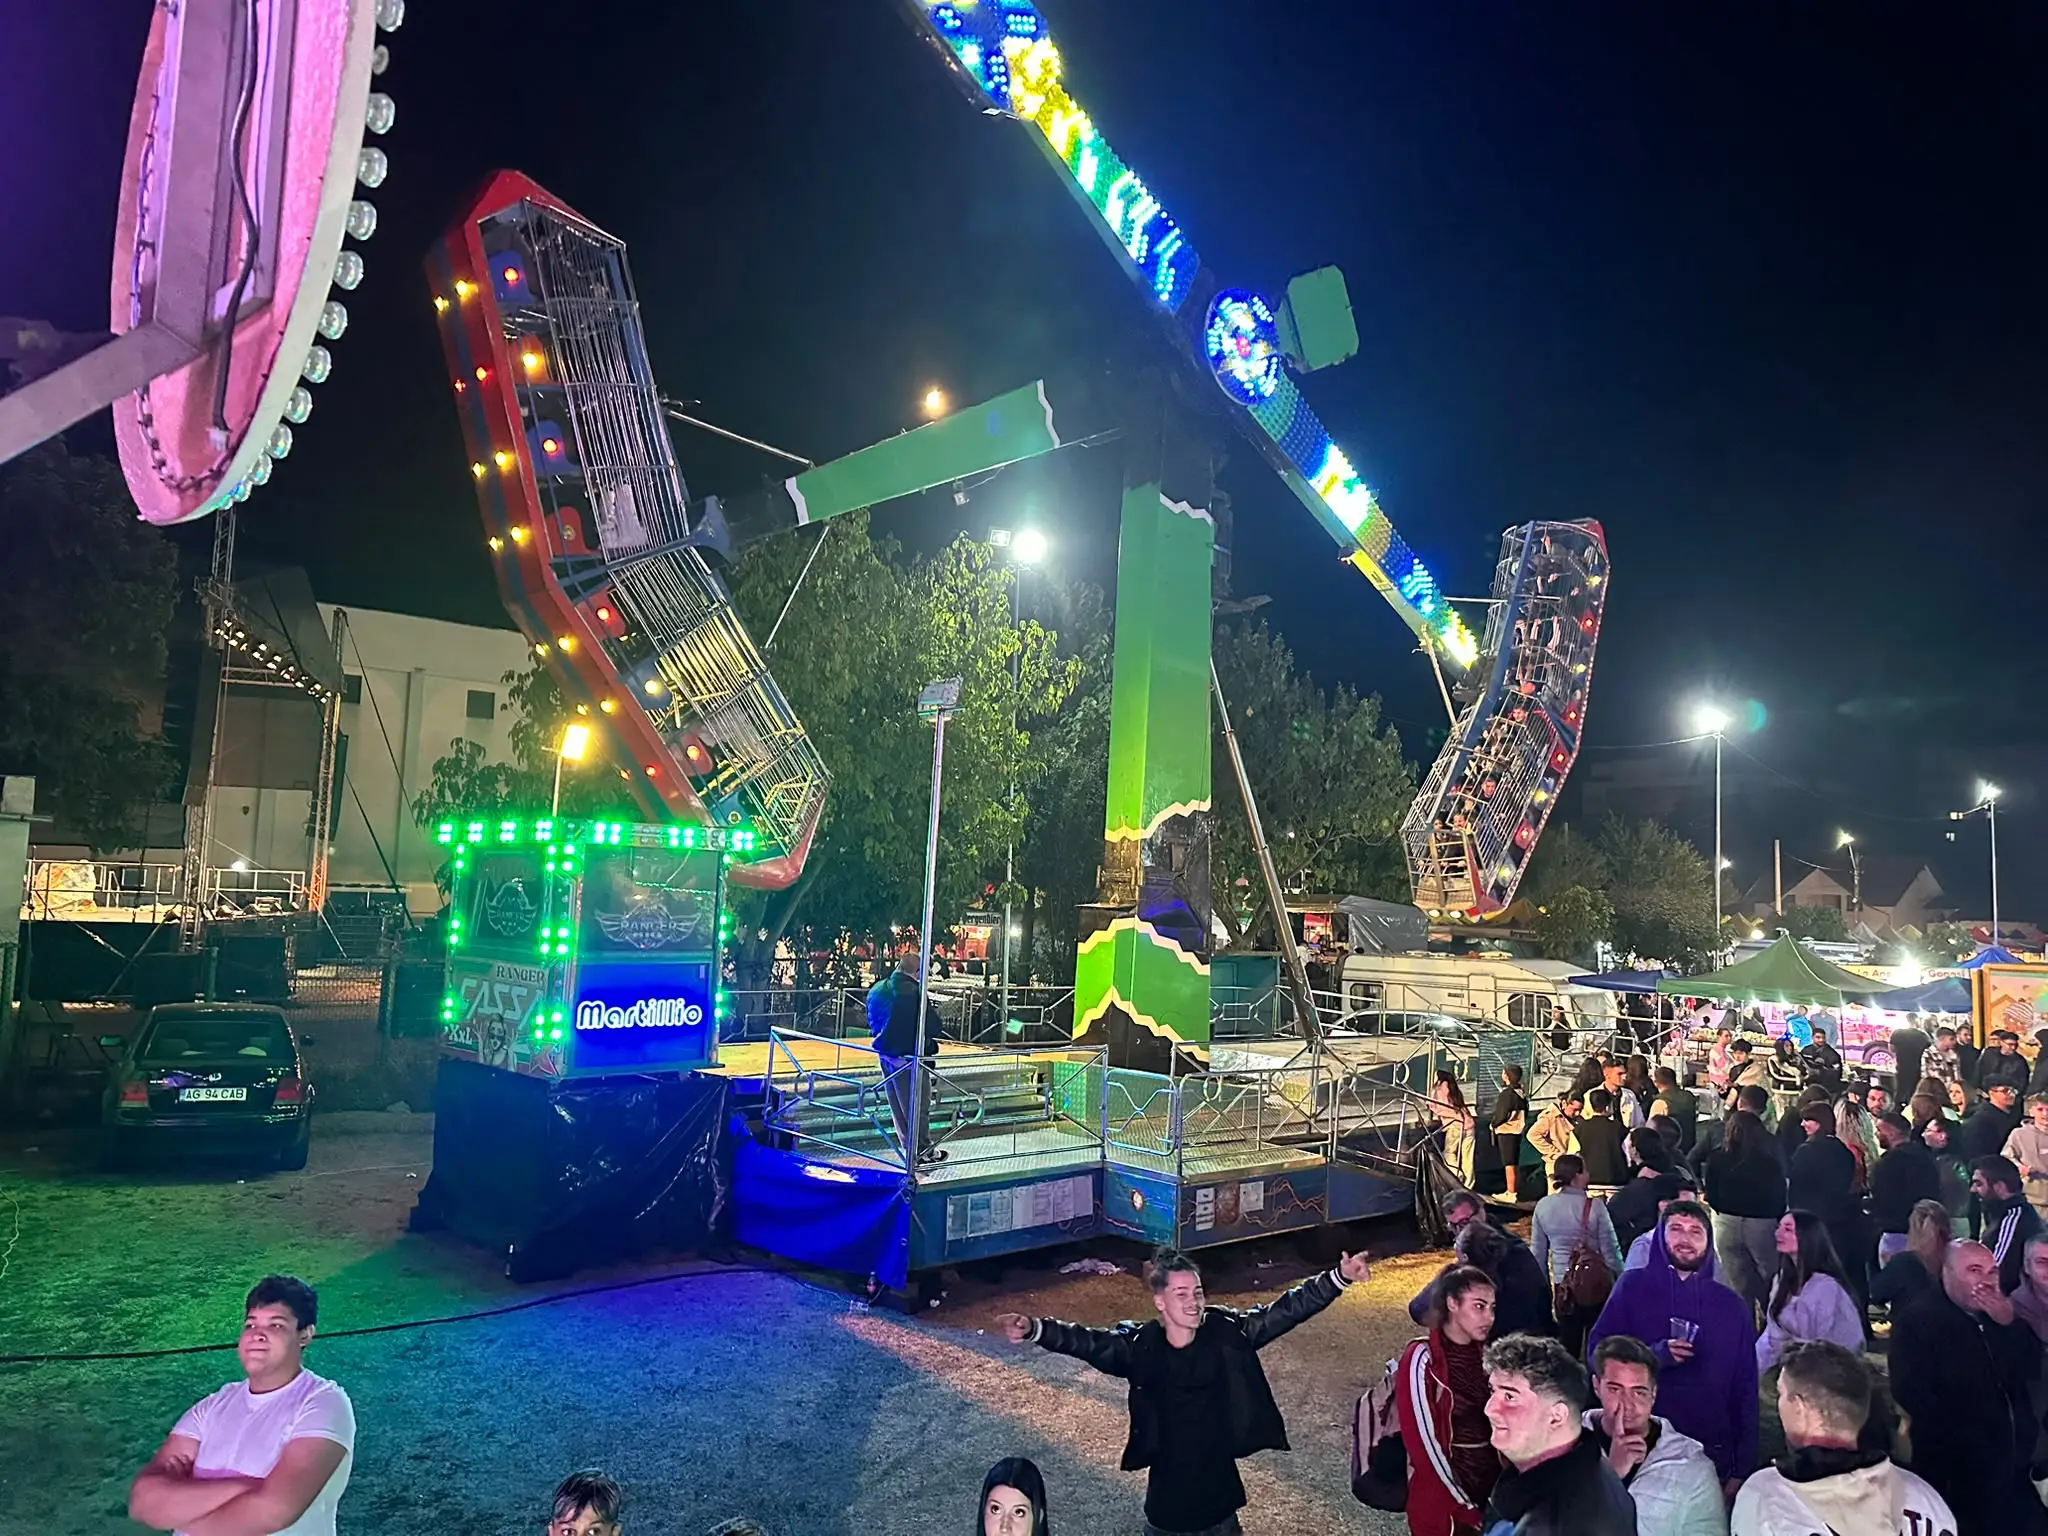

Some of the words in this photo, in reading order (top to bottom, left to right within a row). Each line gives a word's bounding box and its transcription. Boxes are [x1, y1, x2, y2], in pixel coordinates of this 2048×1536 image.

[496, 965, 545, 985] RANGER
[576, 998, 703, 1030] Martillio
[186, 1089, 201, 1099] AG
[205, 1089, 218, 1099] 94
[221, 1089, 244, 1099] CAB
